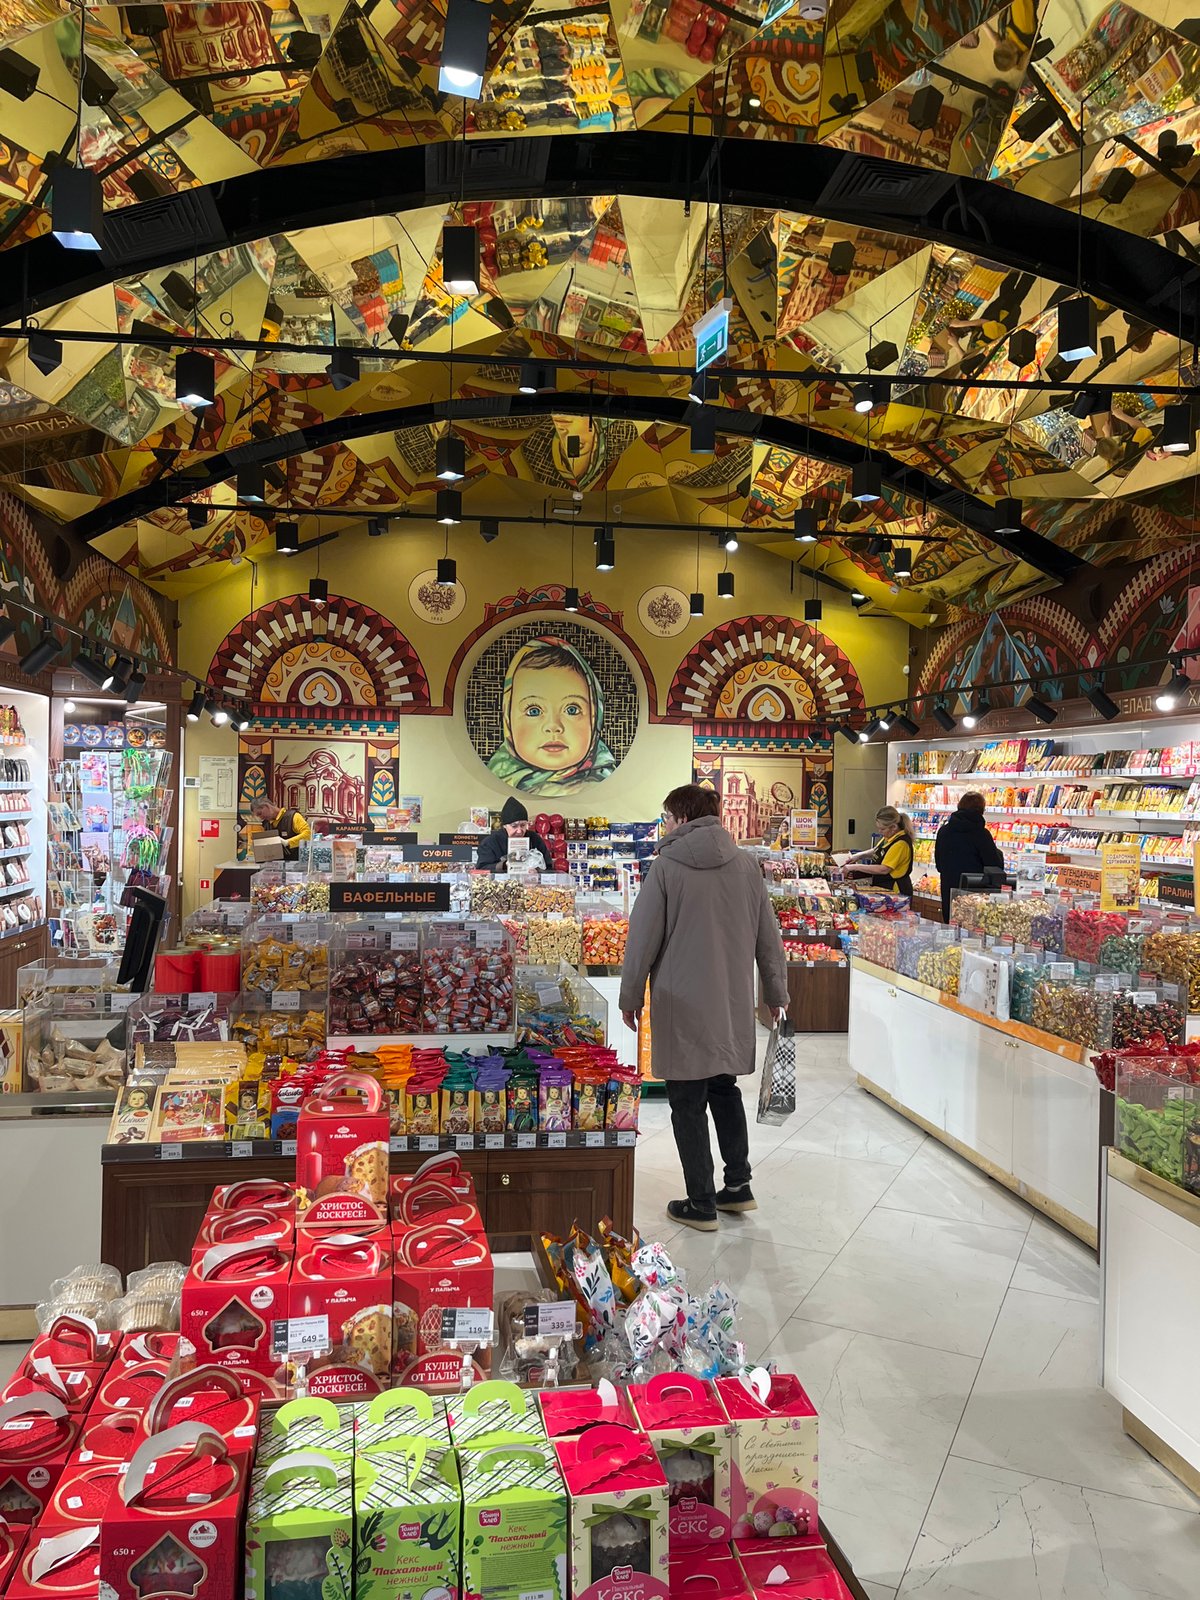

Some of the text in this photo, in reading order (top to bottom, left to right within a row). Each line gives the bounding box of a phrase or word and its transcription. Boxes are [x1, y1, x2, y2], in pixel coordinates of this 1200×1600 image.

[422, 849, 453, 858] СУФЛЕ
[1059, 868, 1100, 880] ЛЕГЕНДАРНЫЕ
[1064, 878, 1092, 888] КОНФЕТЫ
[342, 891, 436, 903] ВАФЕЛЬНЫЕ
[320, 1202, 364, 1210] ХРИСТОС
[316, 1210, 366, 1220] ВОСКРЕСЕ!
[550, 1322, 564, 1330] 339
[302, 1334, 317, 1344] 649
[424, 1361, 460, 1371] КУЛИЧ
[314, 1373, 364, 1384] ХРИСТОС
[411, 1370, 460, 1382] ОТ ПАЛЫ
[310, 1382, 367, 1394] ВОСКРЕСЕ!
[508, 1524, 528, 1533] Кекс
[669, 1518, 708, 1535] Кекс
[488, 1530, 547, 1543] Пасхальный
[500, 1542, 536, 1551] нежный
[113, 1548, 129, 1556] 650
[396, 1555, 420, 1564] Кекс
[372, 1561, 444, 1576] Пасхальный
[386, 1574, 429, 1586] нежный
